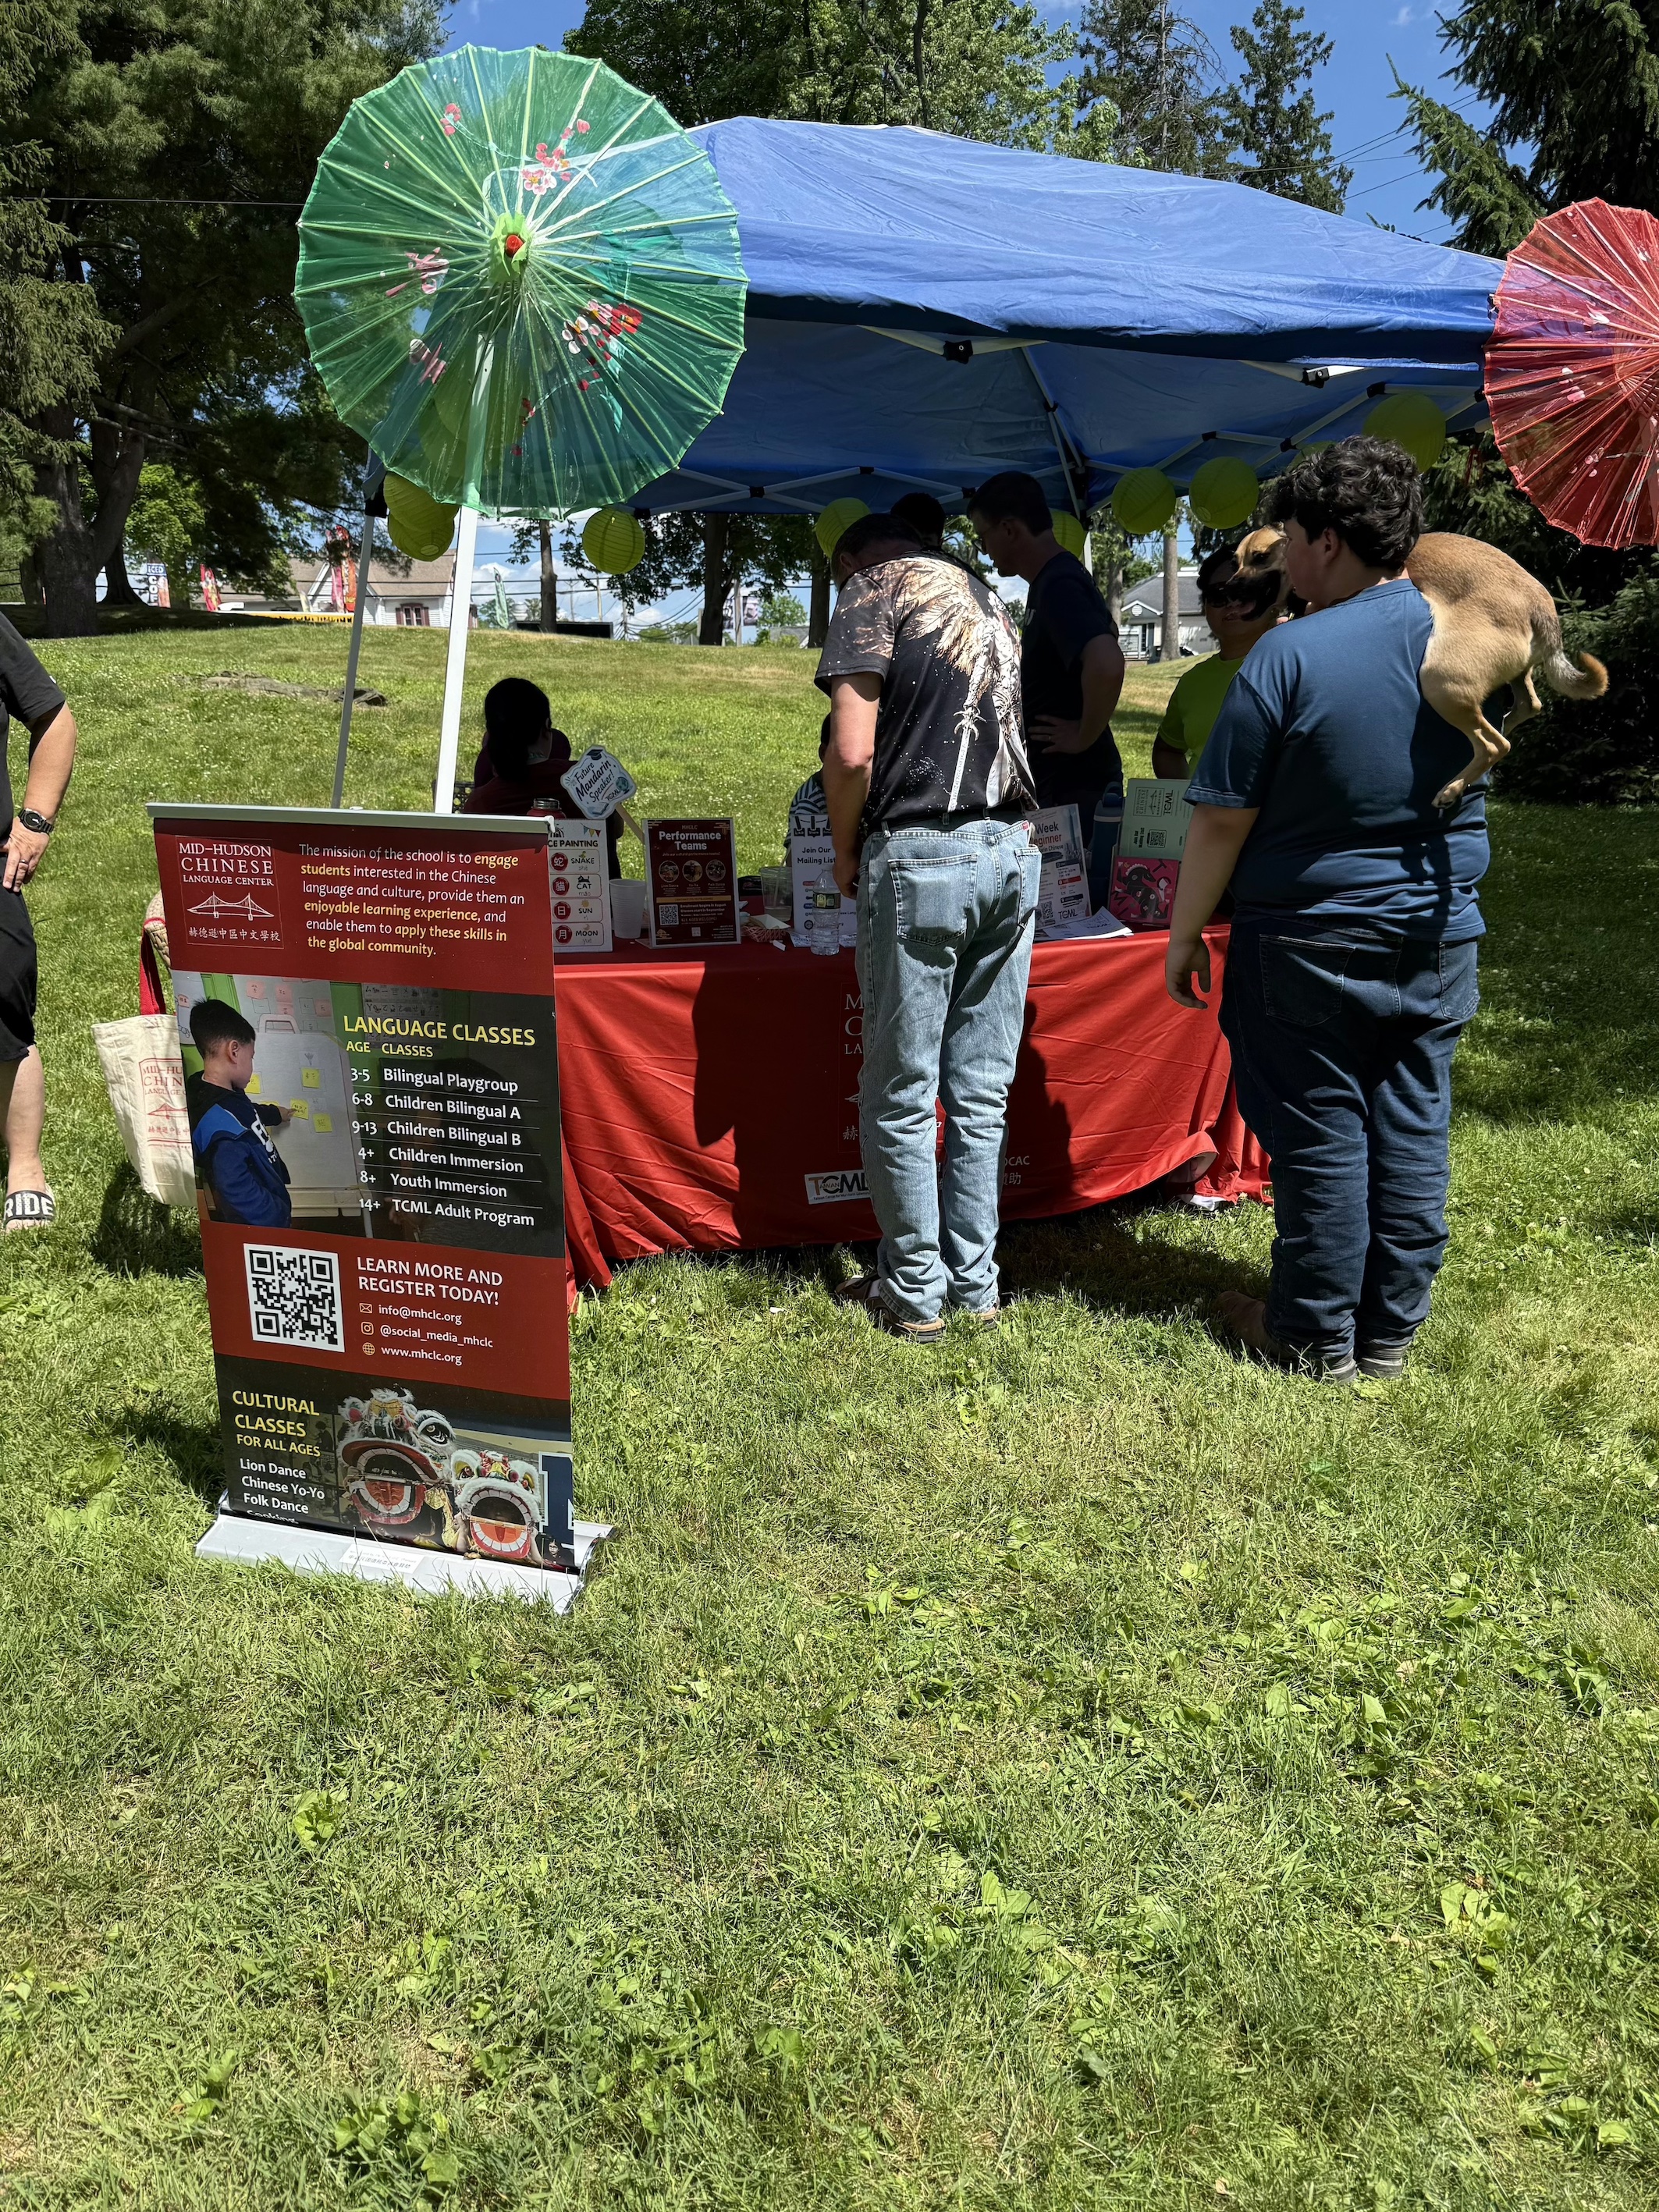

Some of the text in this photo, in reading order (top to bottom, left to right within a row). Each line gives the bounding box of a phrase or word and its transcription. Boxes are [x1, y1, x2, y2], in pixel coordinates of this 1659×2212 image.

[574, 762, 594, 783] Future
[576, 760, 611, 801] Mandarin
[589, 769, 615, 802] Speaker!
[1163, 790, 1173, 815] TCML
[659, 831, 722, 840] Performance
[1036, 821, 1059, 835] Week
[179, 843, 272, 857] MID-HUDSON
[674, 841, 707, 850] Teams
[1034, 834, 1062, 847] eginner
[181, 857, 273, 874] CHINESE
[299, 843, 518, 869] The mission of the school is to engage
[553, 857, 565, 868] 蛇
[183, 874, 274, 886] LANGUAGE CENTER
[300, 863, 496, 884] students interested in the Chinese
[303, 881, 524, 904] language and culture, provide them an
[304, 900, 506, 923] enjoyable learning experience, and
[557, 906, 566, 916] 日
[306, 918, 507, 942] enable them to apply these skills in
[559, 929, 567, 939] 月
[307, 936, 436, 957] the global community.
[343, 1015, 535, 1046] LANGUAGE CLASSES
[346, 1040, 433, 1057] AGE CLASSES
[350, 1067, 518, 1096] 3-5 Bilingual Playgroup
[352, 1092, 521, 1120] 6-8 Children Bilingual A
[352, 1120, 522, 1146] 9-13 Children Bilingual B
[358, 1147, 524, 1173] 4+ Children Immersion
[360, 1170, 507, 1198] 8+ Youth Immersion
[808, 1173, 869, 1195] TCML
[3, 1193, 55, 1220] RIDE
[359, 1198, 535, 1227] 14+ TCML Adult Program
[357, 1256, 503, 1286] LEARN MORE AND
[358, 1276, 499, 1305] REGISTER TODAY!
[378, 1304, 462, 1326] info@mhclc.org
[380, 1324, 493, 1348] @social_media_mhclc
[381, 1346, 462, 1366] www.mhclc.org
[232, 1390, 320, 1416] CULTURAL
[234, 1414, 307, 1437] CLASSES
[236, 1433, 321, 1457] FOR ALL AGES
[240, 1458, 306, 1479] Lion Dance
[241, 1475, 325, 1500] Chinese Yo-Yo
[243, 1492, 309, 1514] Folk Dance
